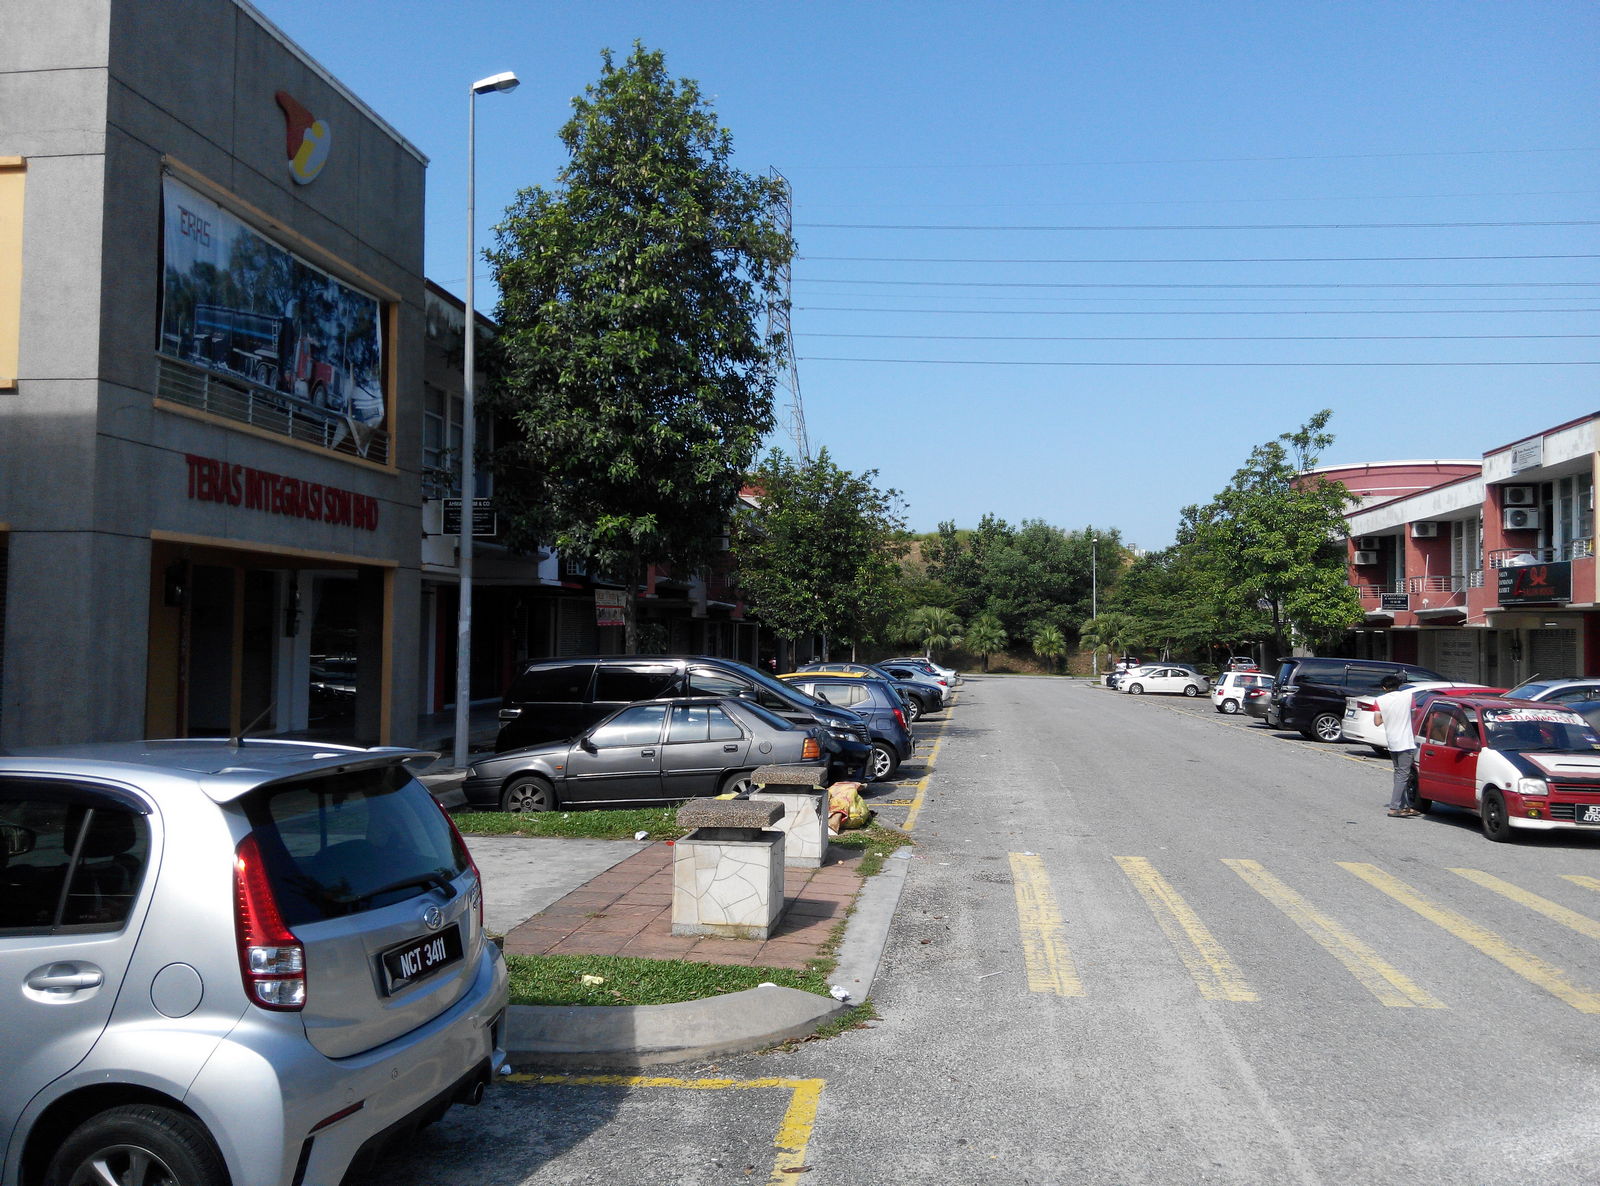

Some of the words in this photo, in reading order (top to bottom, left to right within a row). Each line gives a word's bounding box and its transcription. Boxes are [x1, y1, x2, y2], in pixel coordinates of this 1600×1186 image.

[186, 453, 243, 507] TERAS
[245, 467, 323, 521] INTEGRASI
[324, 484, 353, 527] SDN
[353, 492, 379, 532] BHD
[400, 948, 422, 978] NCT
[424, 937, 446, 966] 3411
